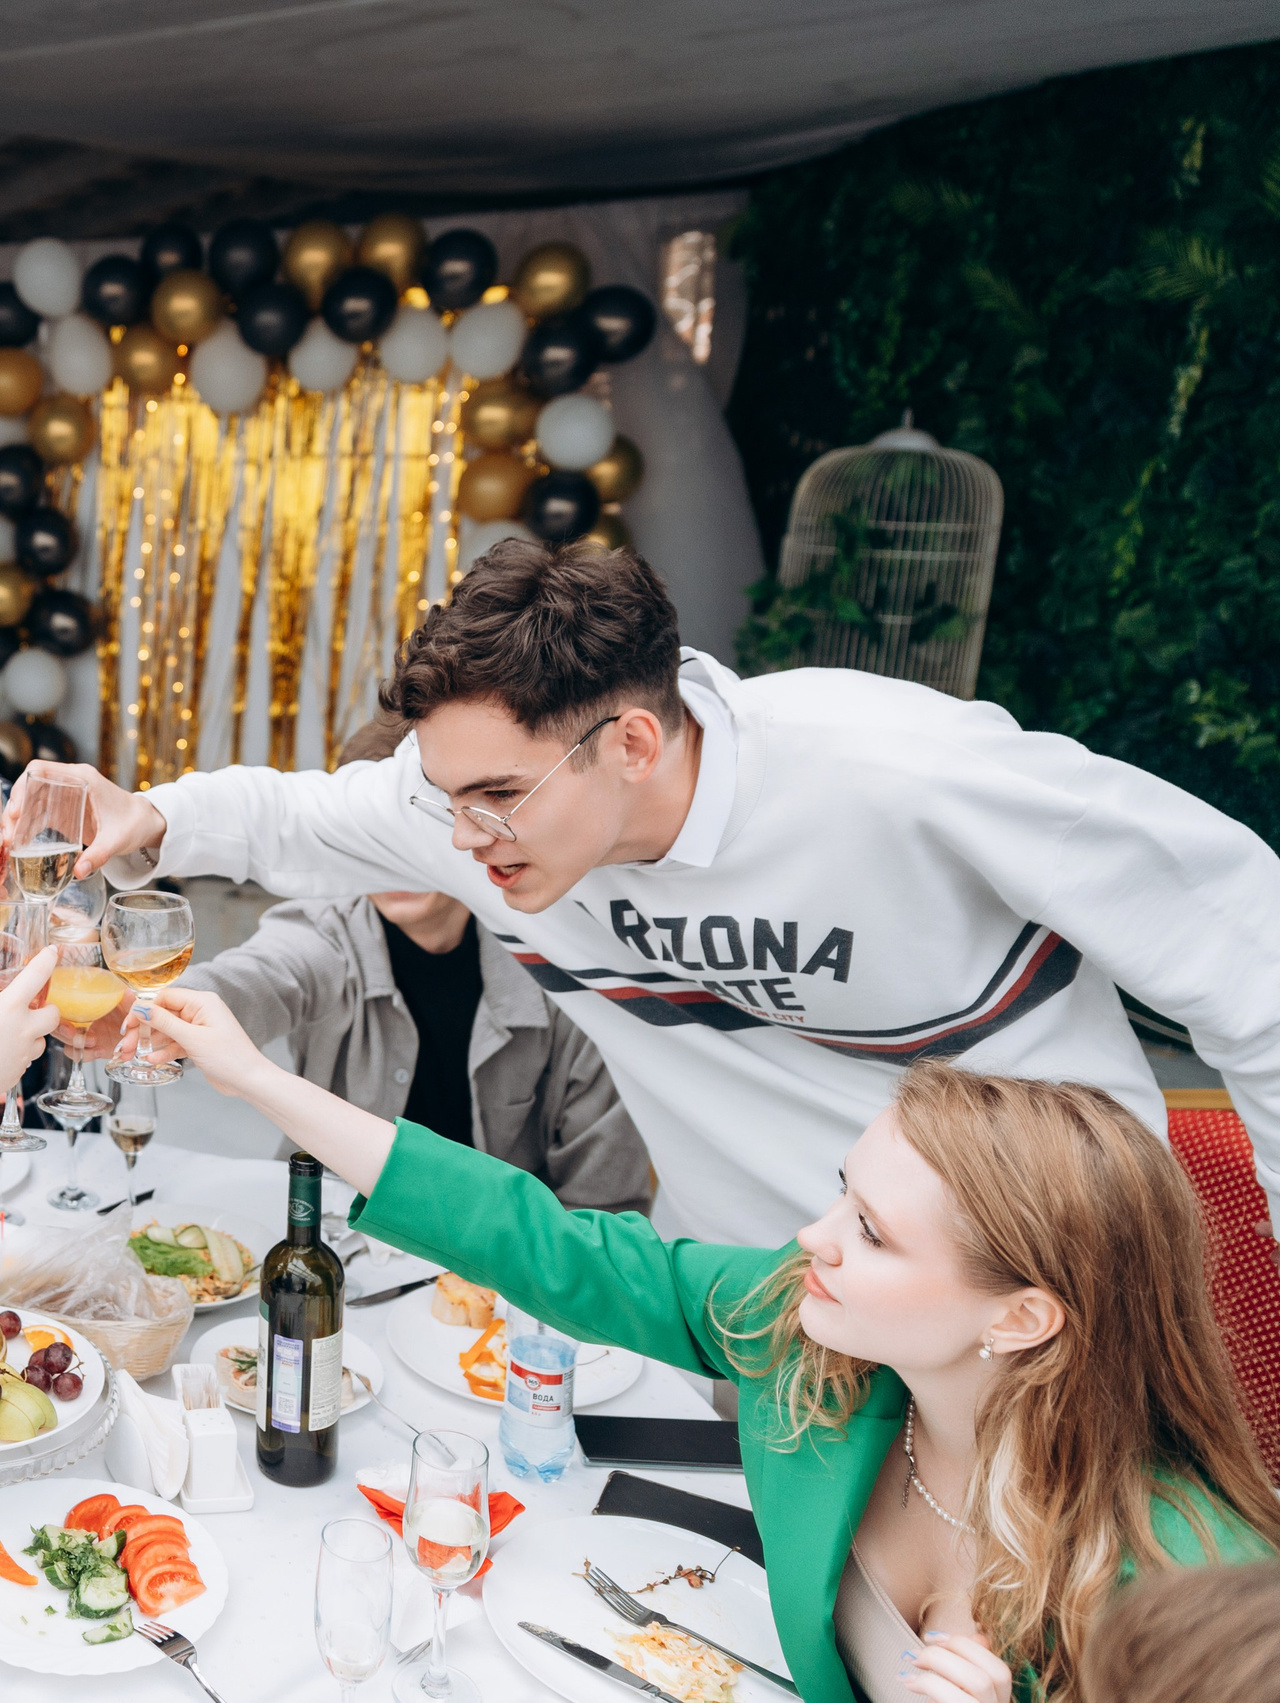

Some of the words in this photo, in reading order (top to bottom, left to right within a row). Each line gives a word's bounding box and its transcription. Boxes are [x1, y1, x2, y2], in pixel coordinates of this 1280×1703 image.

[574, 898, 854, 984] RZONA
[701, 976, 807, 1012] ATE
[773, 1013, 806, 1023] CITY
[532, 1393, 554, 1402] ВОДА
